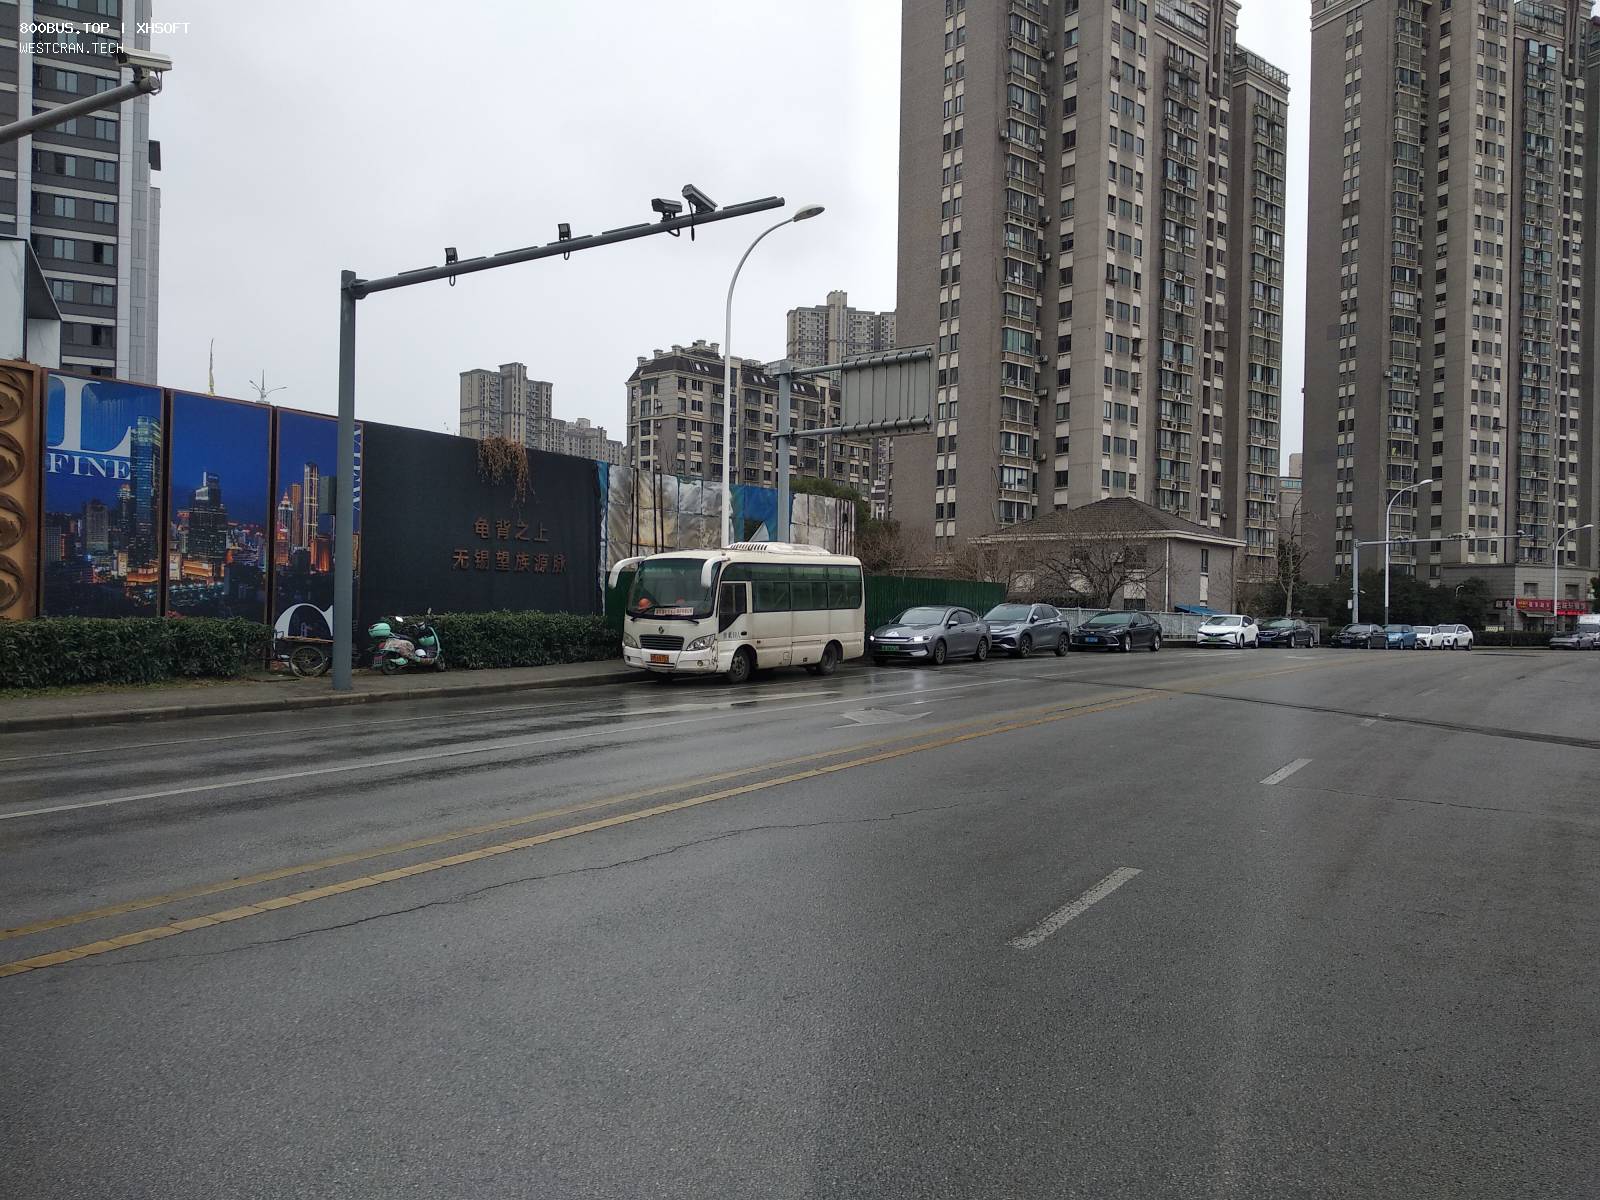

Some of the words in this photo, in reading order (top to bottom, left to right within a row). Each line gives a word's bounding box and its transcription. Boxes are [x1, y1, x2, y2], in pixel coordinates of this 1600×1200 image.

[46, 453, 131, 480] FINE
[474, 517, 550, 542] 龟背之上
[451, 548, 568, 574] 无锡望族源脉
